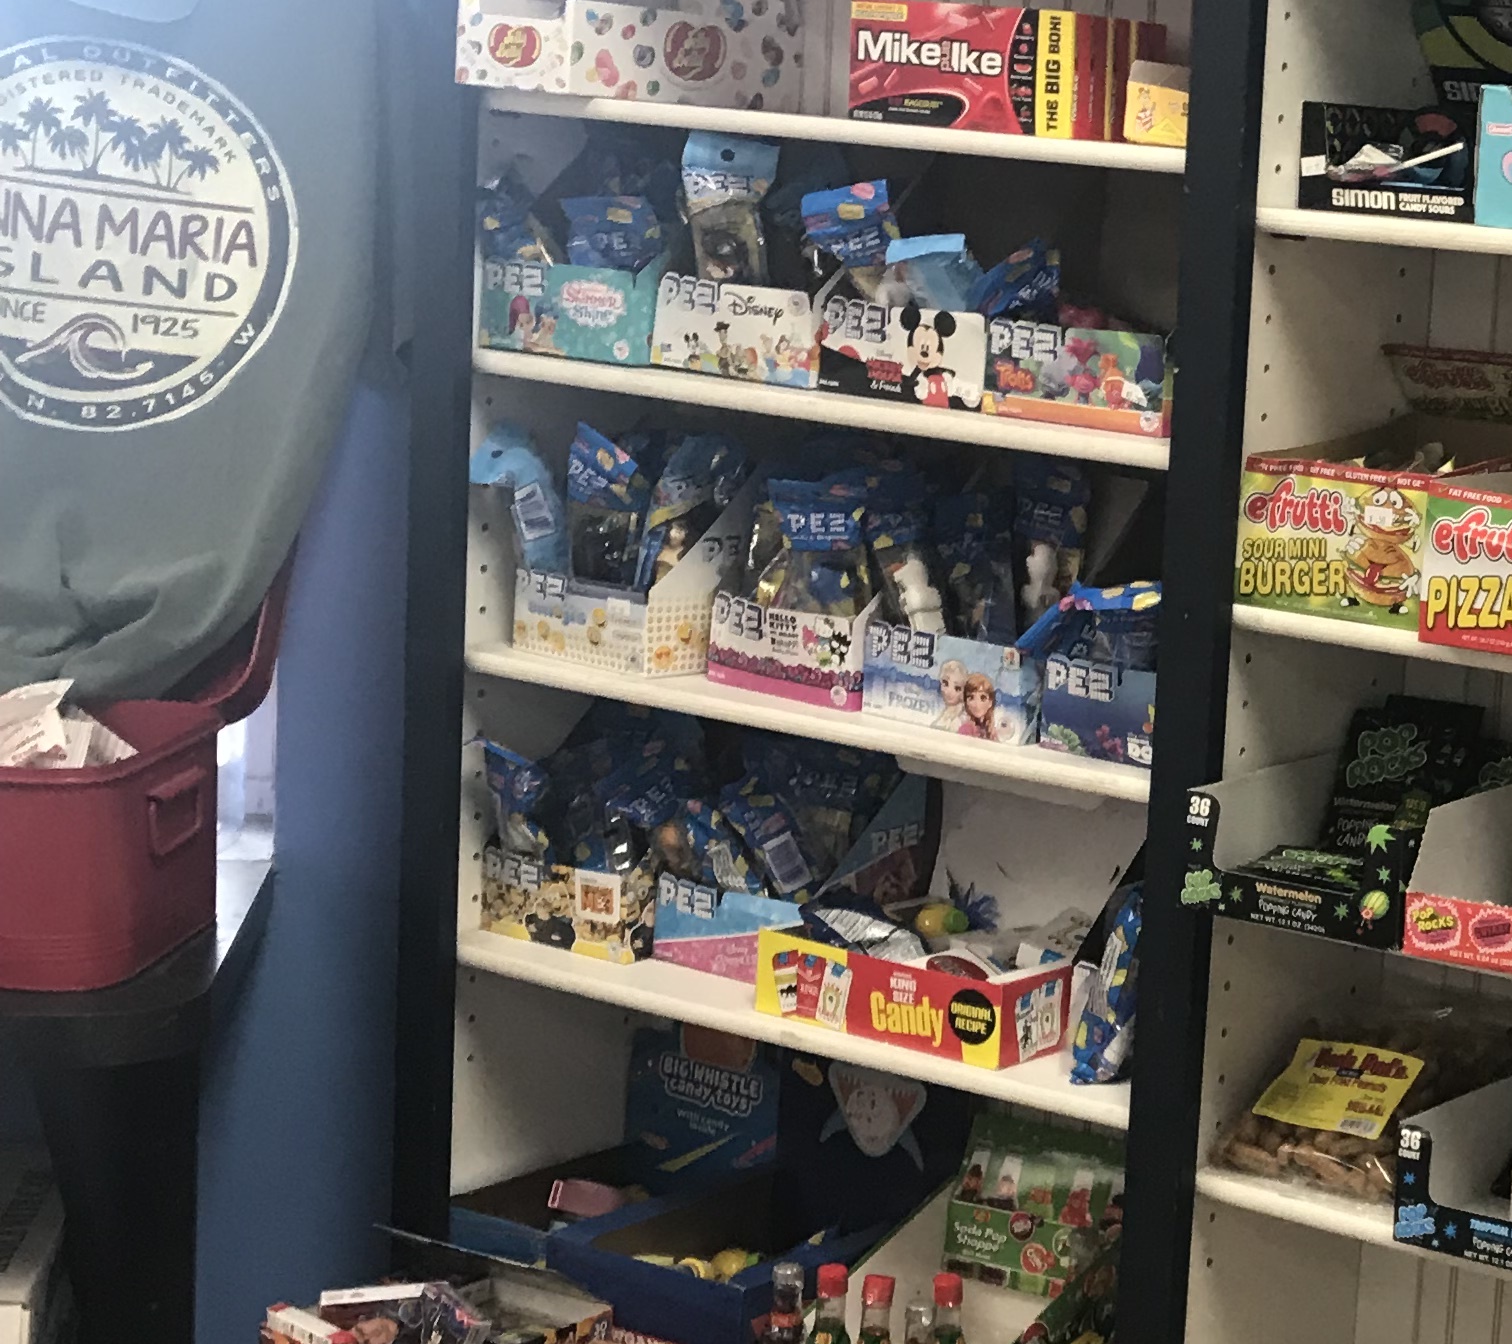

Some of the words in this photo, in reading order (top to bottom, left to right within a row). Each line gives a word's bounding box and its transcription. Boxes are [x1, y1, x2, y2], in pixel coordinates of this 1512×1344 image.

[857, 30, 941, 66] Mike
[951, 42, 1002, 76] Ike
[1044, 58, 1061, 96] BIG
[0, 68, 104, 108] ISTERED
[120, 72, 237, 165] TRADEMARK
[1045, 99, 1060, 132] THE
[1398, 193, 1418, 203] FRUIT
[1419, 194, 1465, 207] FLAVORED
[1399, 202, 1430, 214] CANDY
[1431, 204, 1456, 216] SOURS
[96, 202, 258, 269] MARIA
[0, 245, 238, 303] SLAND
[723, 291, 784, 327] Disney
[823, 295, 890, 344] PEZ
[131, 312, 200, 340] 1925
[989, 317, 1061, 361] PEZ
[1243, 478, 1349, 534] efrutti
[1241, 538, 1287, 558] SOUR
[1288, 538, 1328, 559] MINI
[1238, 560, 1348, 596] BURGER
[869, 621, 938, 670] PEZ
[1048, 656, 1120, 702] PEZ
[1188, 794, 1212, 818] 36
[1254, 881, 1322, 905] Watermelon
[1257, 898, 1290, 917] POPPING
[1291, 904, 1318, 922] CANDY
[1411, 907, 1436, 923] POP
[1417, 915, 1455, 932] ROCKS
[889, 976, 918, 993] KING
[892, 990, 916, 1004] SIZE
[870, 991, 944, 1047] Candy
[950, 1001, 993, 1024] ORIGINAL
[954, 1017, 987, 1036] RECIPE
[662, 1055, 691, 1077] BIG
[694, 1061, 761, 1099] WHISTLE
[1399, 1128, 1422, 1151] 36
[953, 1220, 983, 1239] Soda
[984, 1227, 1009, 1245] Pop
[956, 1233, 1001, 1254] Shoppe
